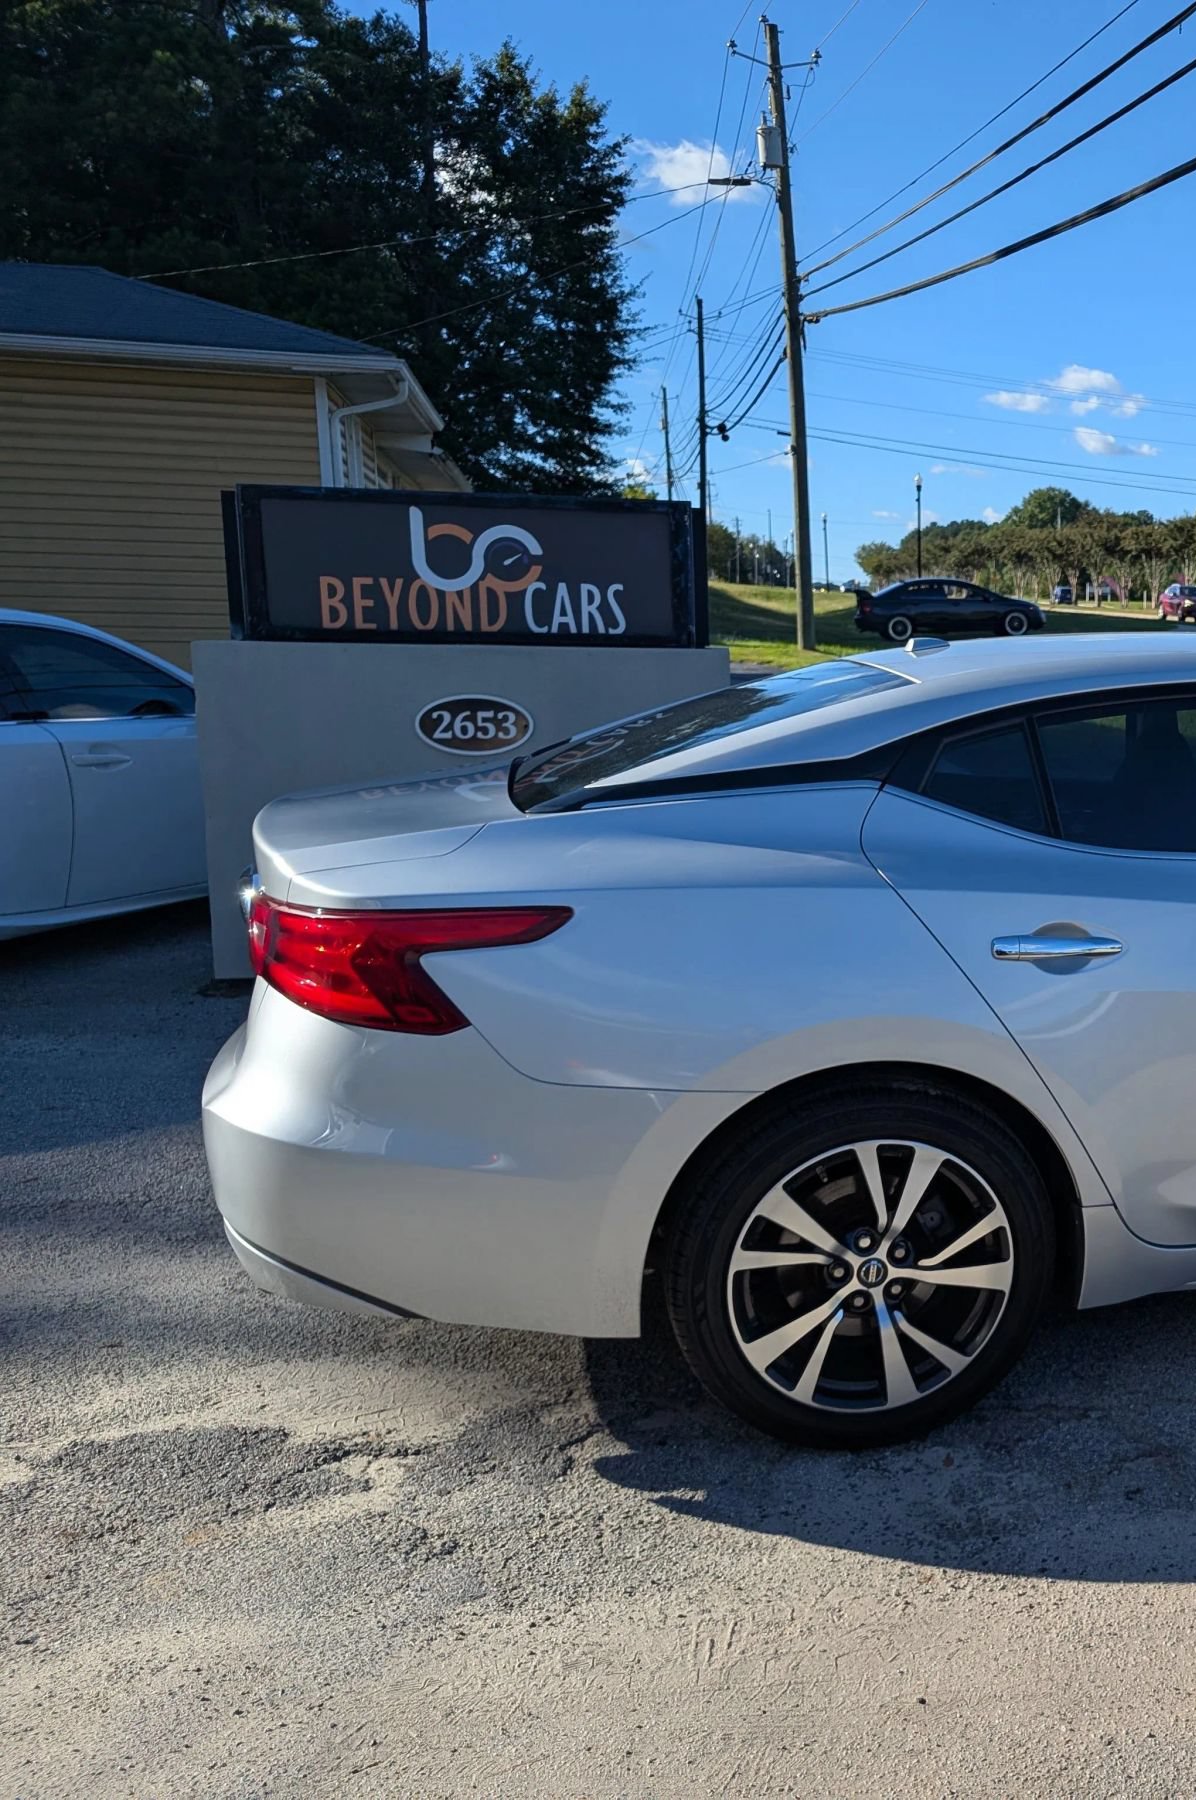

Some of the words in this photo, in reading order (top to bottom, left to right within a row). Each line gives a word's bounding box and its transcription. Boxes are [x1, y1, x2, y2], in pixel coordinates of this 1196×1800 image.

[319, 576, 507, 632] BEYOND
[525, 582, 627, 634] CARS
[431, 710, 517, 740] 2653
